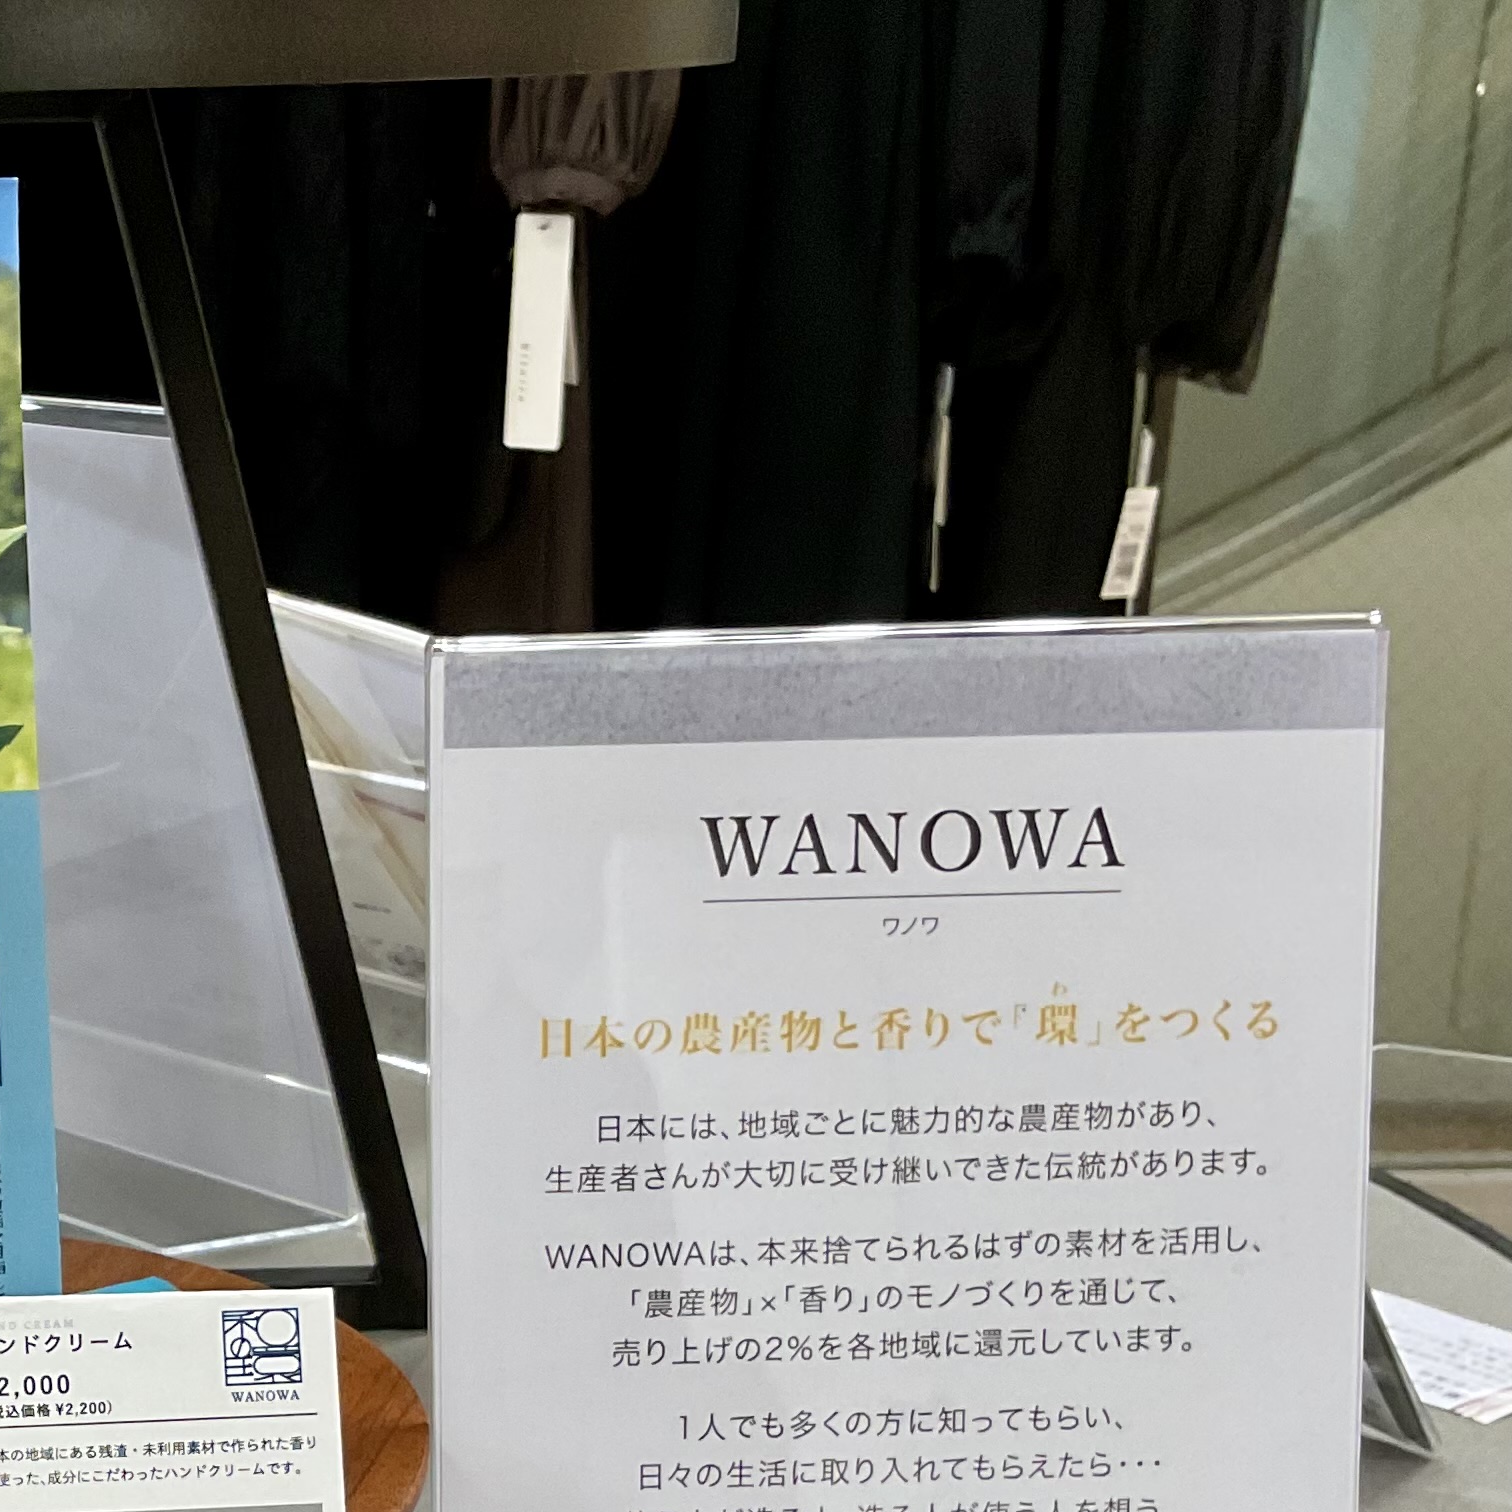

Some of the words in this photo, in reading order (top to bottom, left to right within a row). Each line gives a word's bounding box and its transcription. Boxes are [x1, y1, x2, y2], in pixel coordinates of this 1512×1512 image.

[699, 805, 1127, 880] WANOWA
[882, 914, 941, 938] ワノワ
[594, 1099, 1223, 1145] 日本には、地域ごとに魅力的な農産物があり、
[543, 1144, 1277, 1196] 生産者さんが大切に受け継いできた伝統があります。
[543, 1224, 1265, 1273] WANOWAは、本来捨てられるはずの素材を活用し、
[23, 1318, 75, 1331] CREAM
[611, 1325, 1196, 1369] 売り上げの2%を各地域に還元しています。
[231, 1389, 301, 1404] WANOWA
[676, 1402, 1127, 1442] 1人でも多くの方に知ってもらい、
